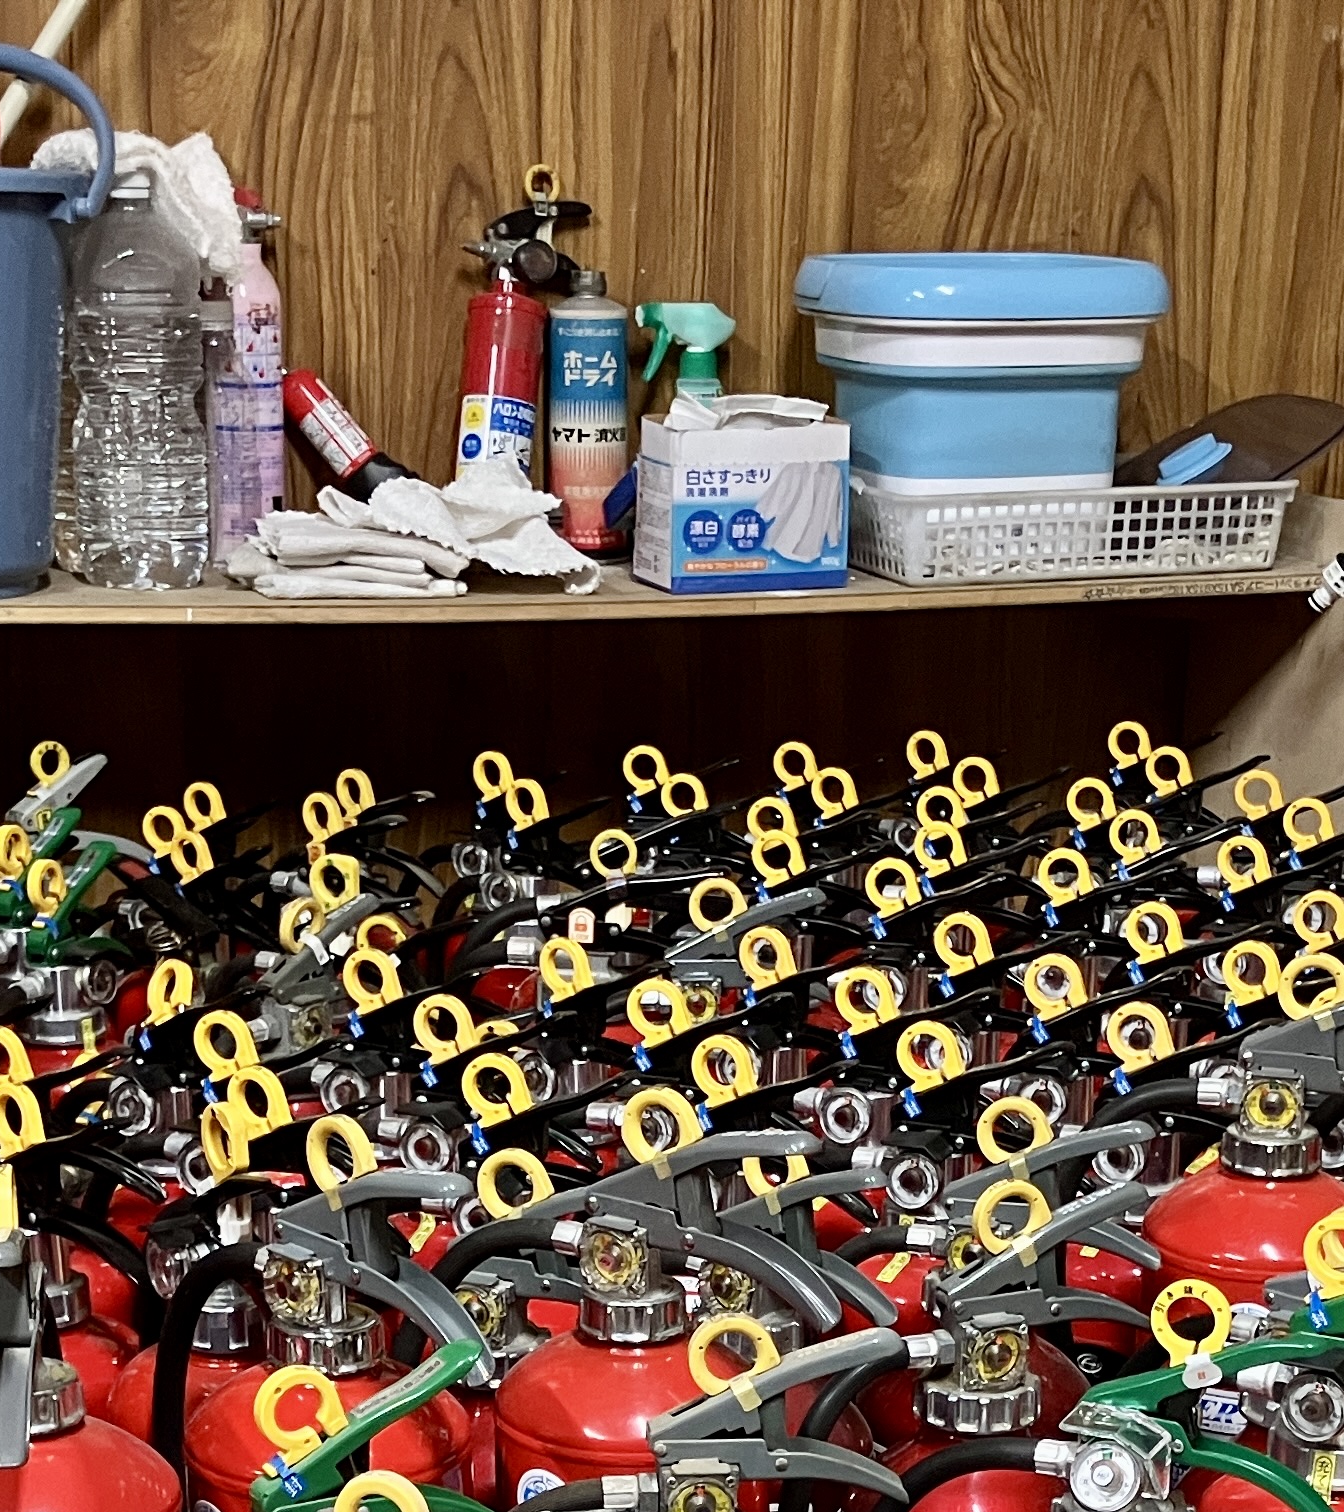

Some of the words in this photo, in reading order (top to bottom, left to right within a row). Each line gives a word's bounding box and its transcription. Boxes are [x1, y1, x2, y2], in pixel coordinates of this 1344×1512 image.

[563, 350, 618, 369] ホーム
[564, 368, 617, 388] ドライ
[552, 427, 591, 443] ヤマト
[685, 467, 772, 486] 白さすっきり
